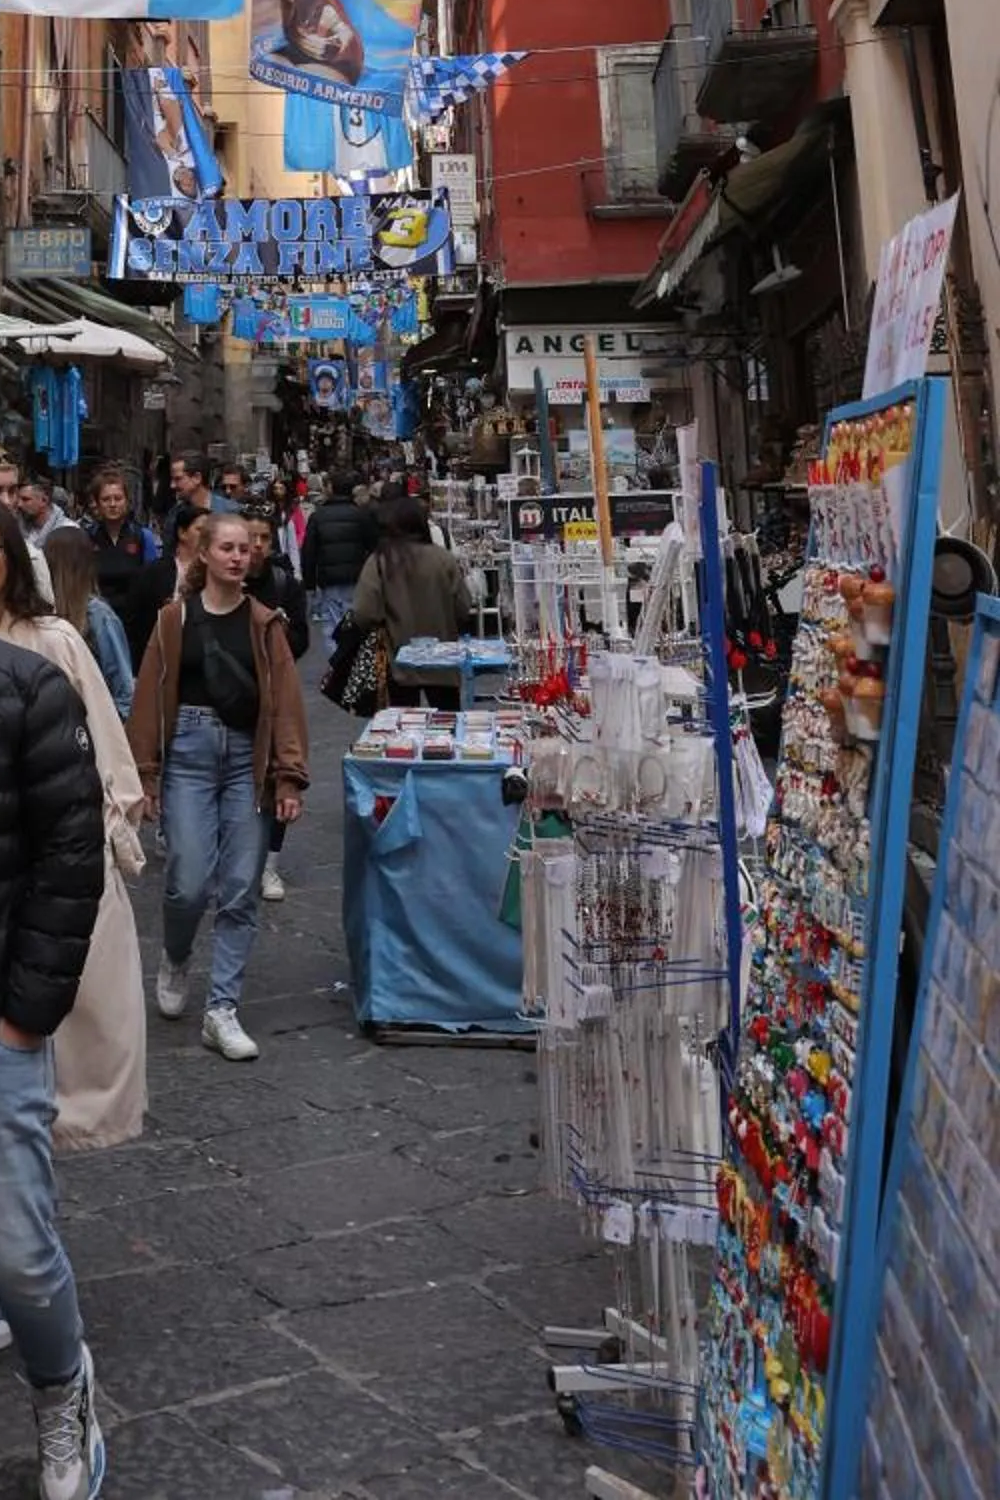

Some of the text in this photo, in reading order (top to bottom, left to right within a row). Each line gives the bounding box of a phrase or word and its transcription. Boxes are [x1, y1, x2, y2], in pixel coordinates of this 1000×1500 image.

[183, 198, 373, 242] AMORE
[128, 238, 375, 276] SENZA FINE
